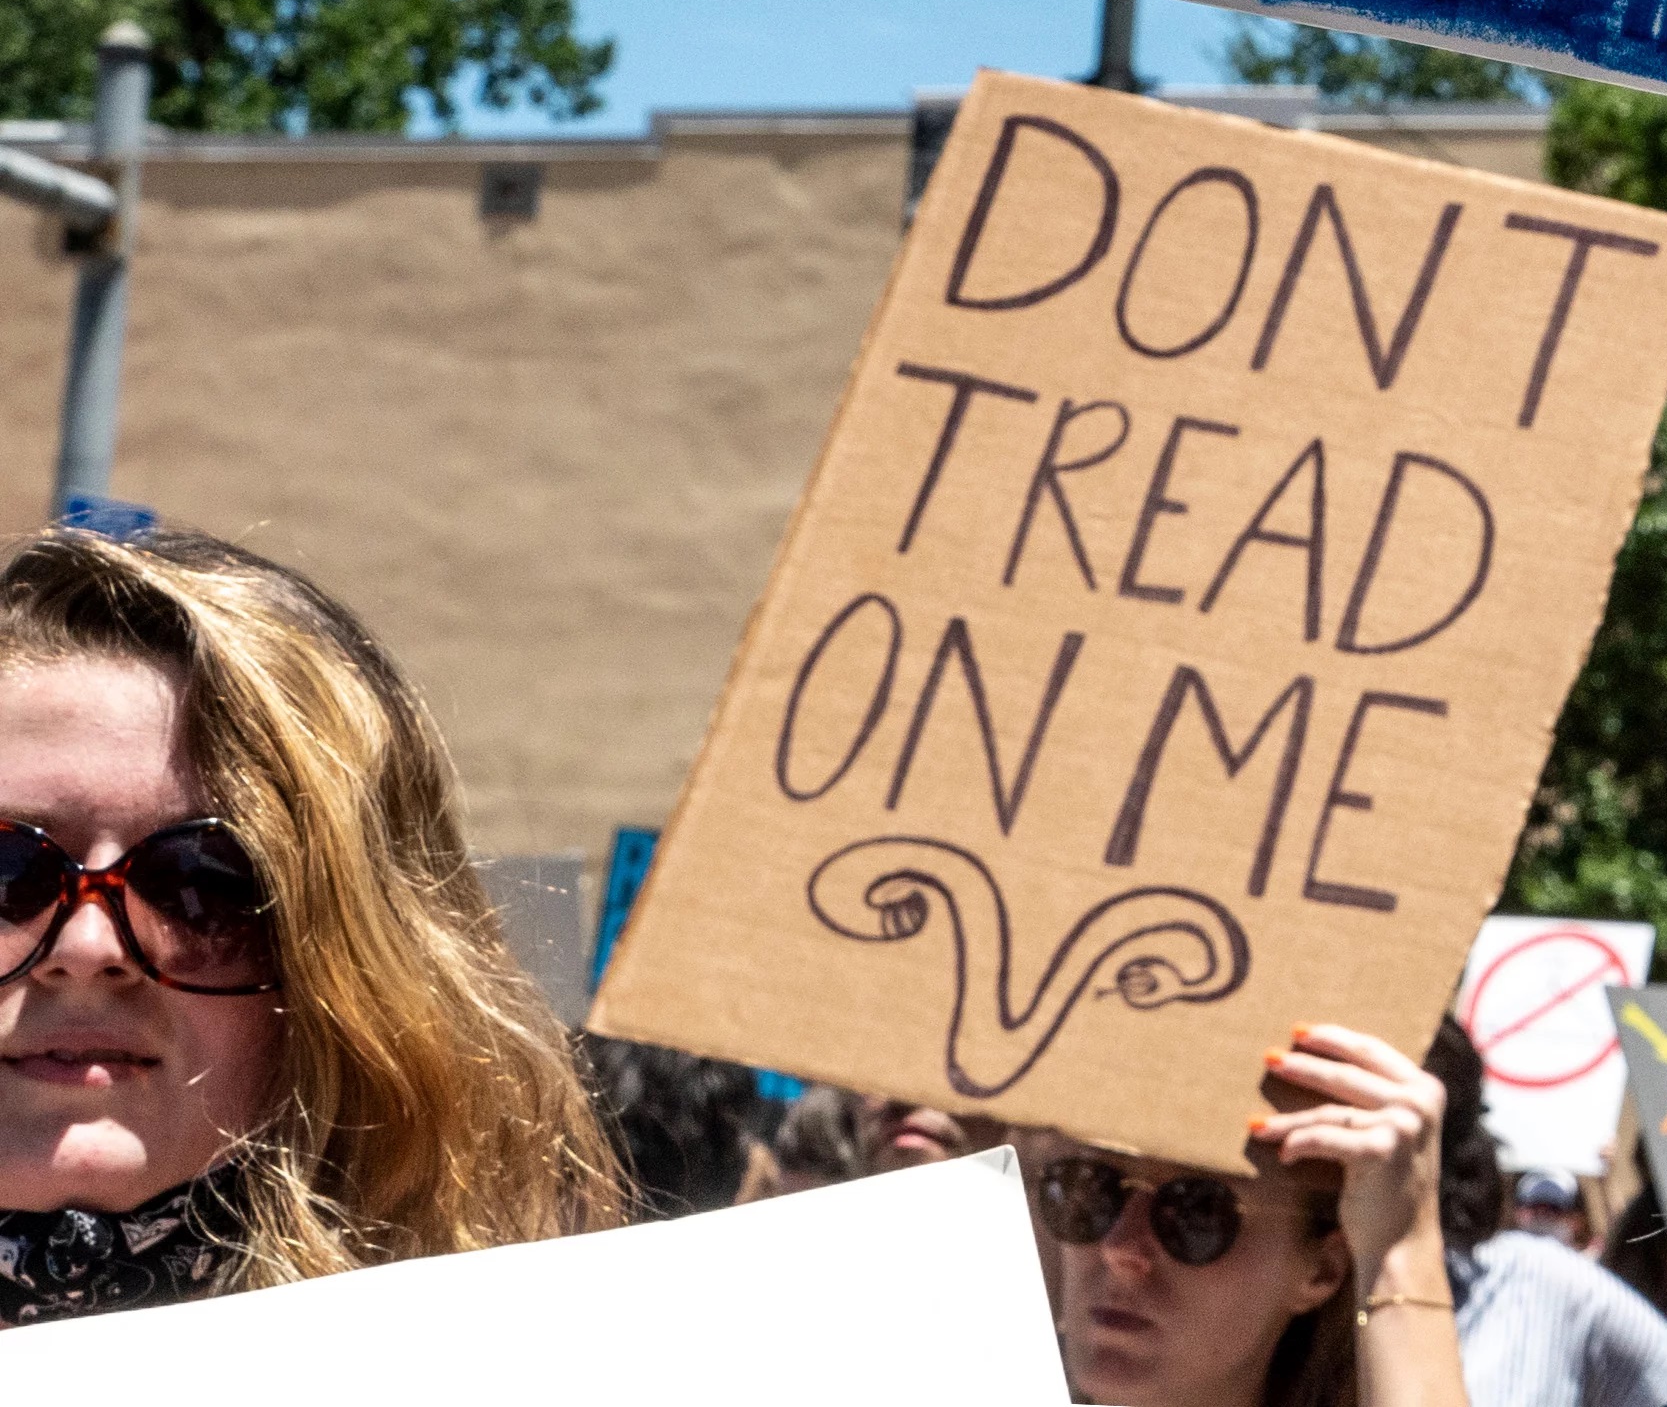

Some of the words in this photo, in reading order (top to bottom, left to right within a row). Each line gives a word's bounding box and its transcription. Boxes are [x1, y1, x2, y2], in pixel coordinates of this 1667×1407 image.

[896, 362, 1495, 656] TREAD
[775, 592, 1085, 838] ON
[1104, 663, 1448, 912] ME
